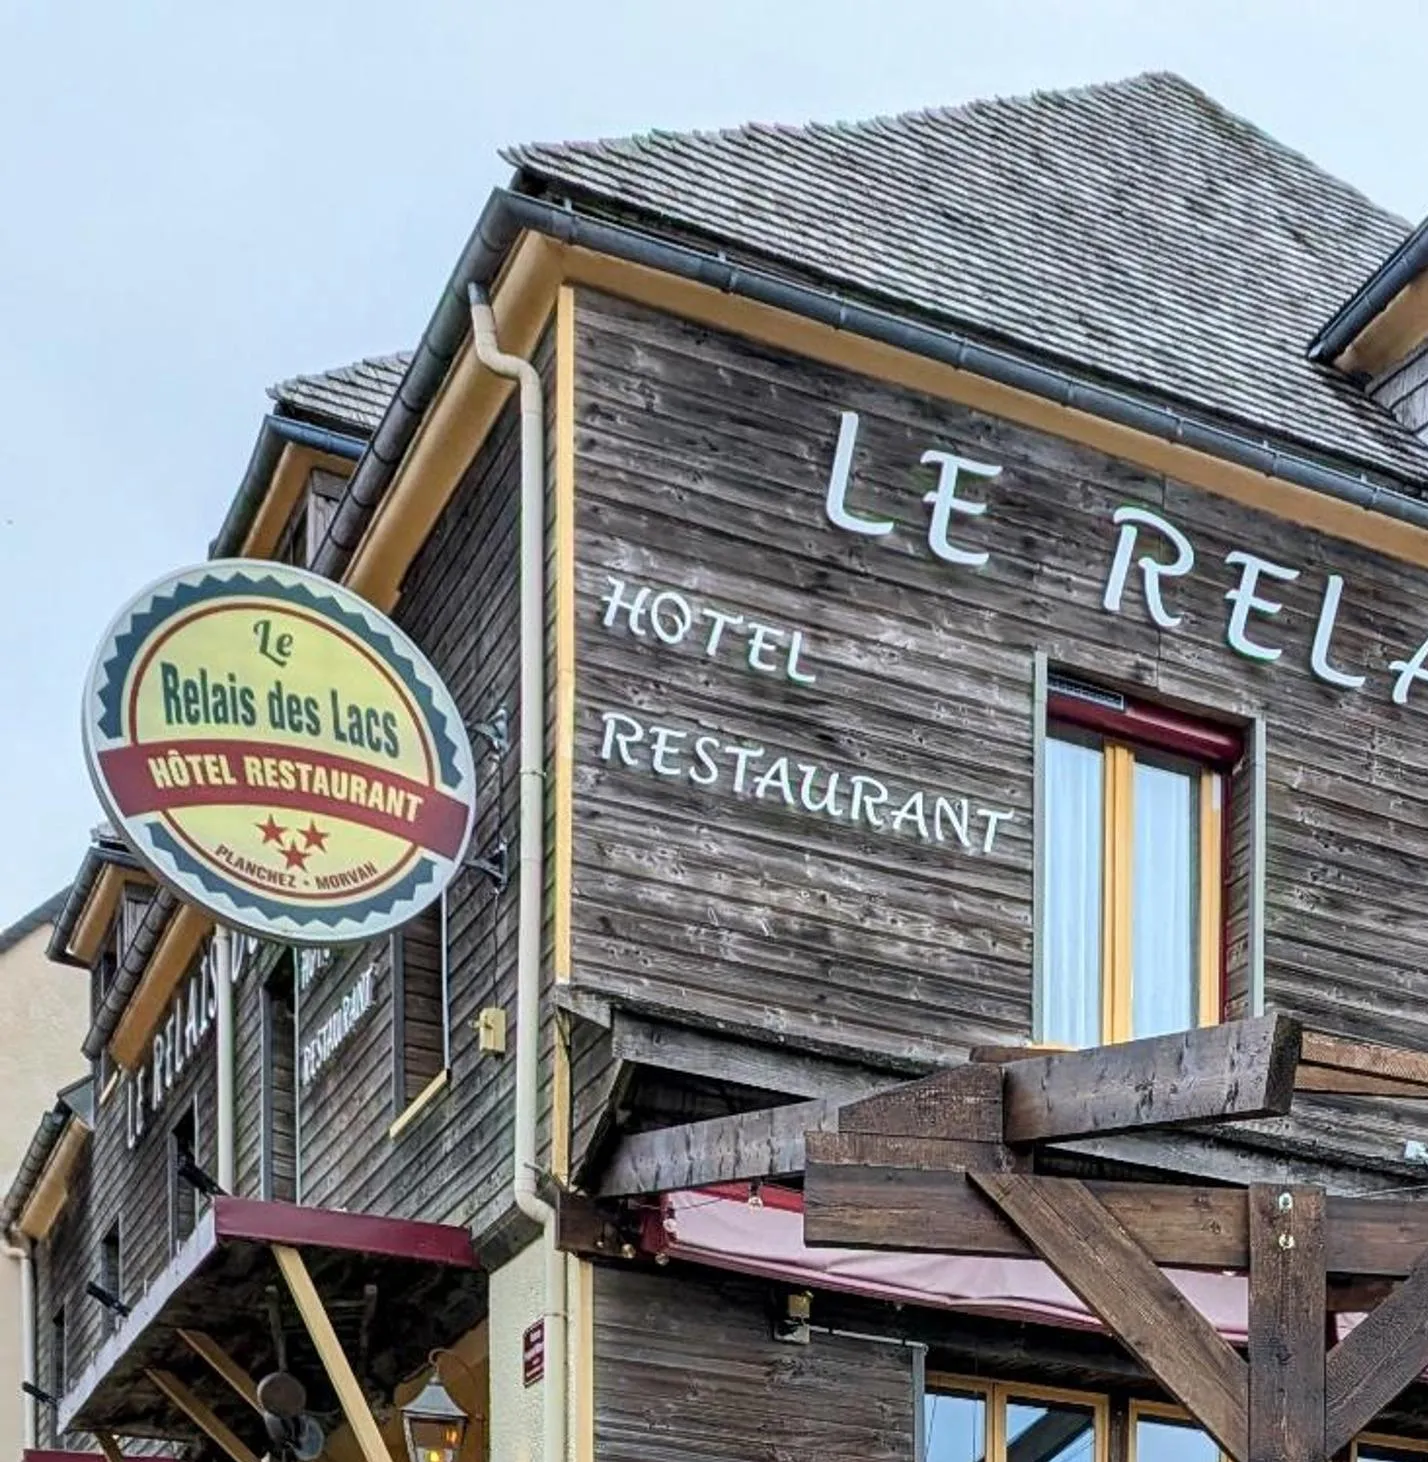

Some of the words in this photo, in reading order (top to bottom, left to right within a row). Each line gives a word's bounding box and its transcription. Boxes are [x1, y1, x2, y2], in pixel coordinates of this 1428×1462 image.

[825, 411, 1002, 566] LE
[253, 619, 294, 668] Le
[602, 576, 817, 684] HOTEL
[160, 661, 257, 728] Relais
[268, 680, 321, 738] des
[331, 689, 400, 760] Lacs
[148, 749, 236, 790] HÔTEL
[244, 760, 424, 823] RESTAURANT
[600, 712, 1015, 853] RESTAURANT
[215, 844, 298, 889] PLANCHEZ
[315, 860, 379, 891] MORVAN
